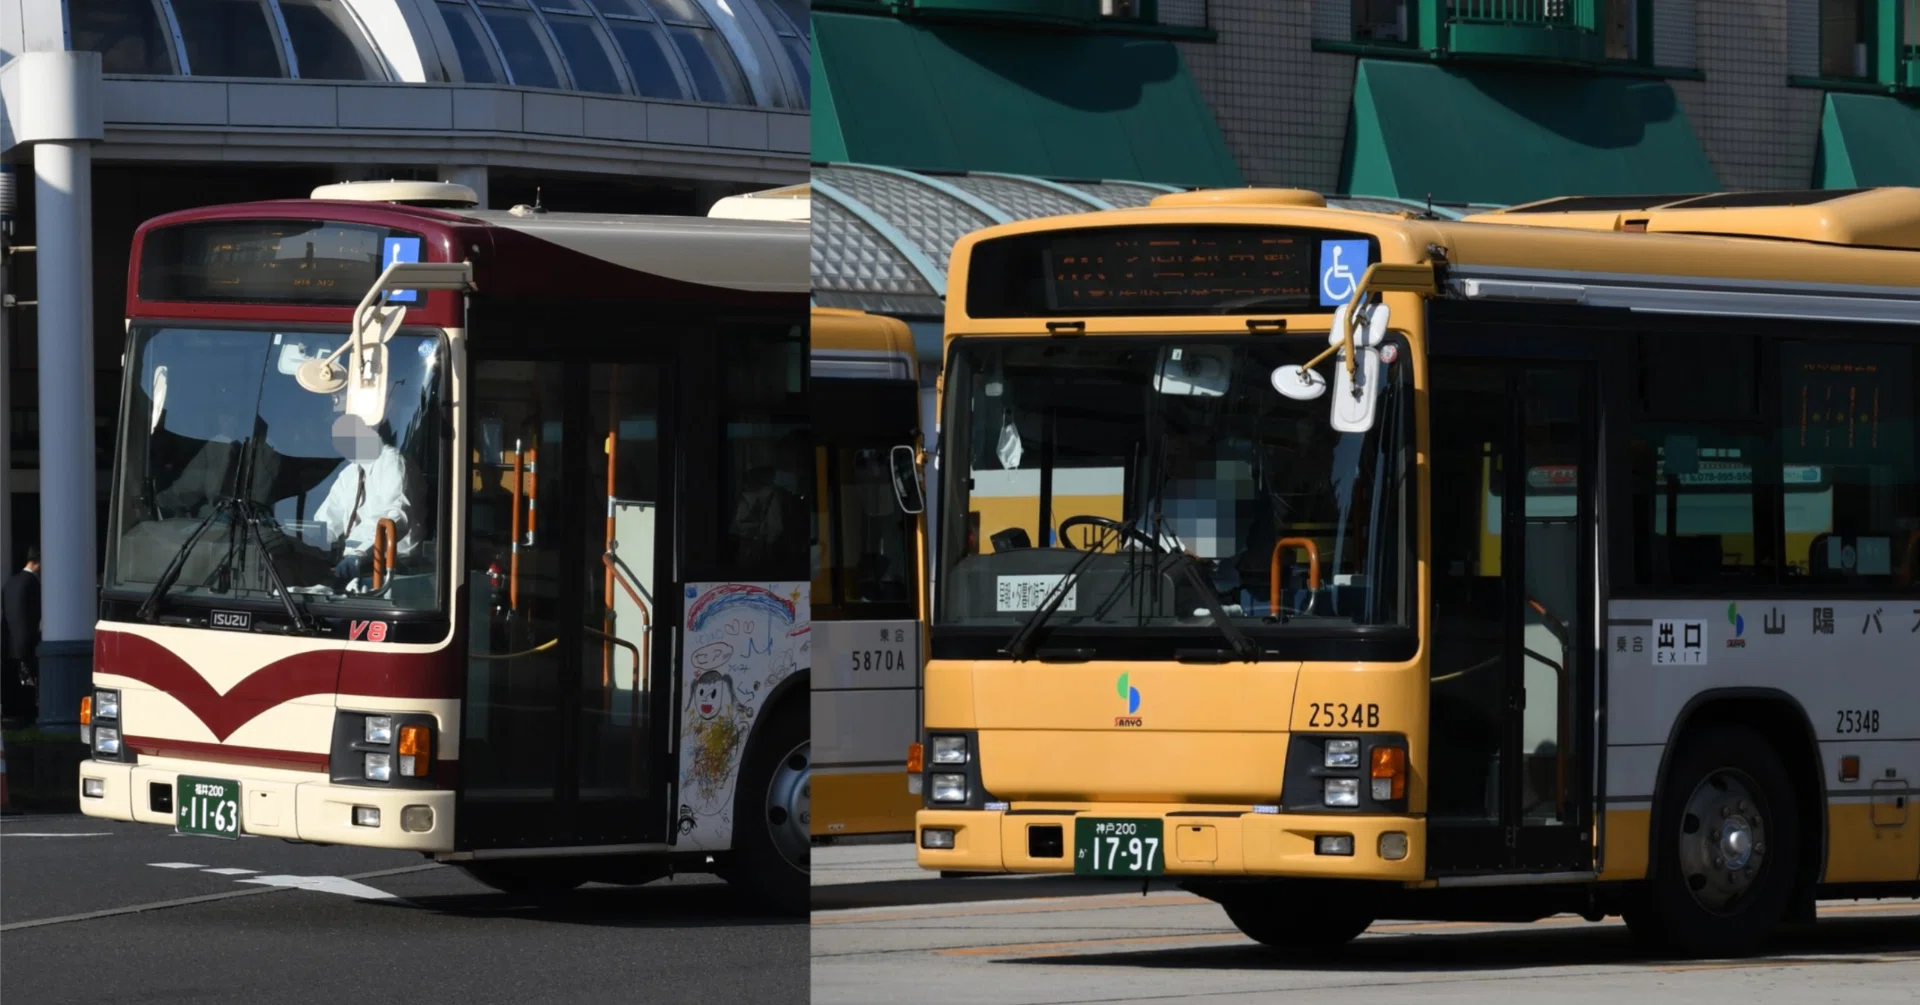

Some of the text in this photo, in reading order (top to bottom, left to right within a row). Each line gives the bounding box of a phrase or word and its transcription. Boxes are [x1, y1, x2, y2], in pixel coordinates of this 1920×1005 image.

[213, 613, 248, 627] ISUZU
[349, 620, 388, 642] V8
[1658, 622, 1701, 649] 出口
[852, 650, 905, 671] 5870A
[1657, 651, 1702, 663] EXIT
[1114, 716, 1142, 727] SANYO
[1309, 703, 1380, 729] 2534B
[1836, 710, 1880, 734] 2534B
[191, 796, 237, 832] 11-63
[1096, 823, 1137, 835] 神戸200
[1093, 836, 1159, 871] 17-97
